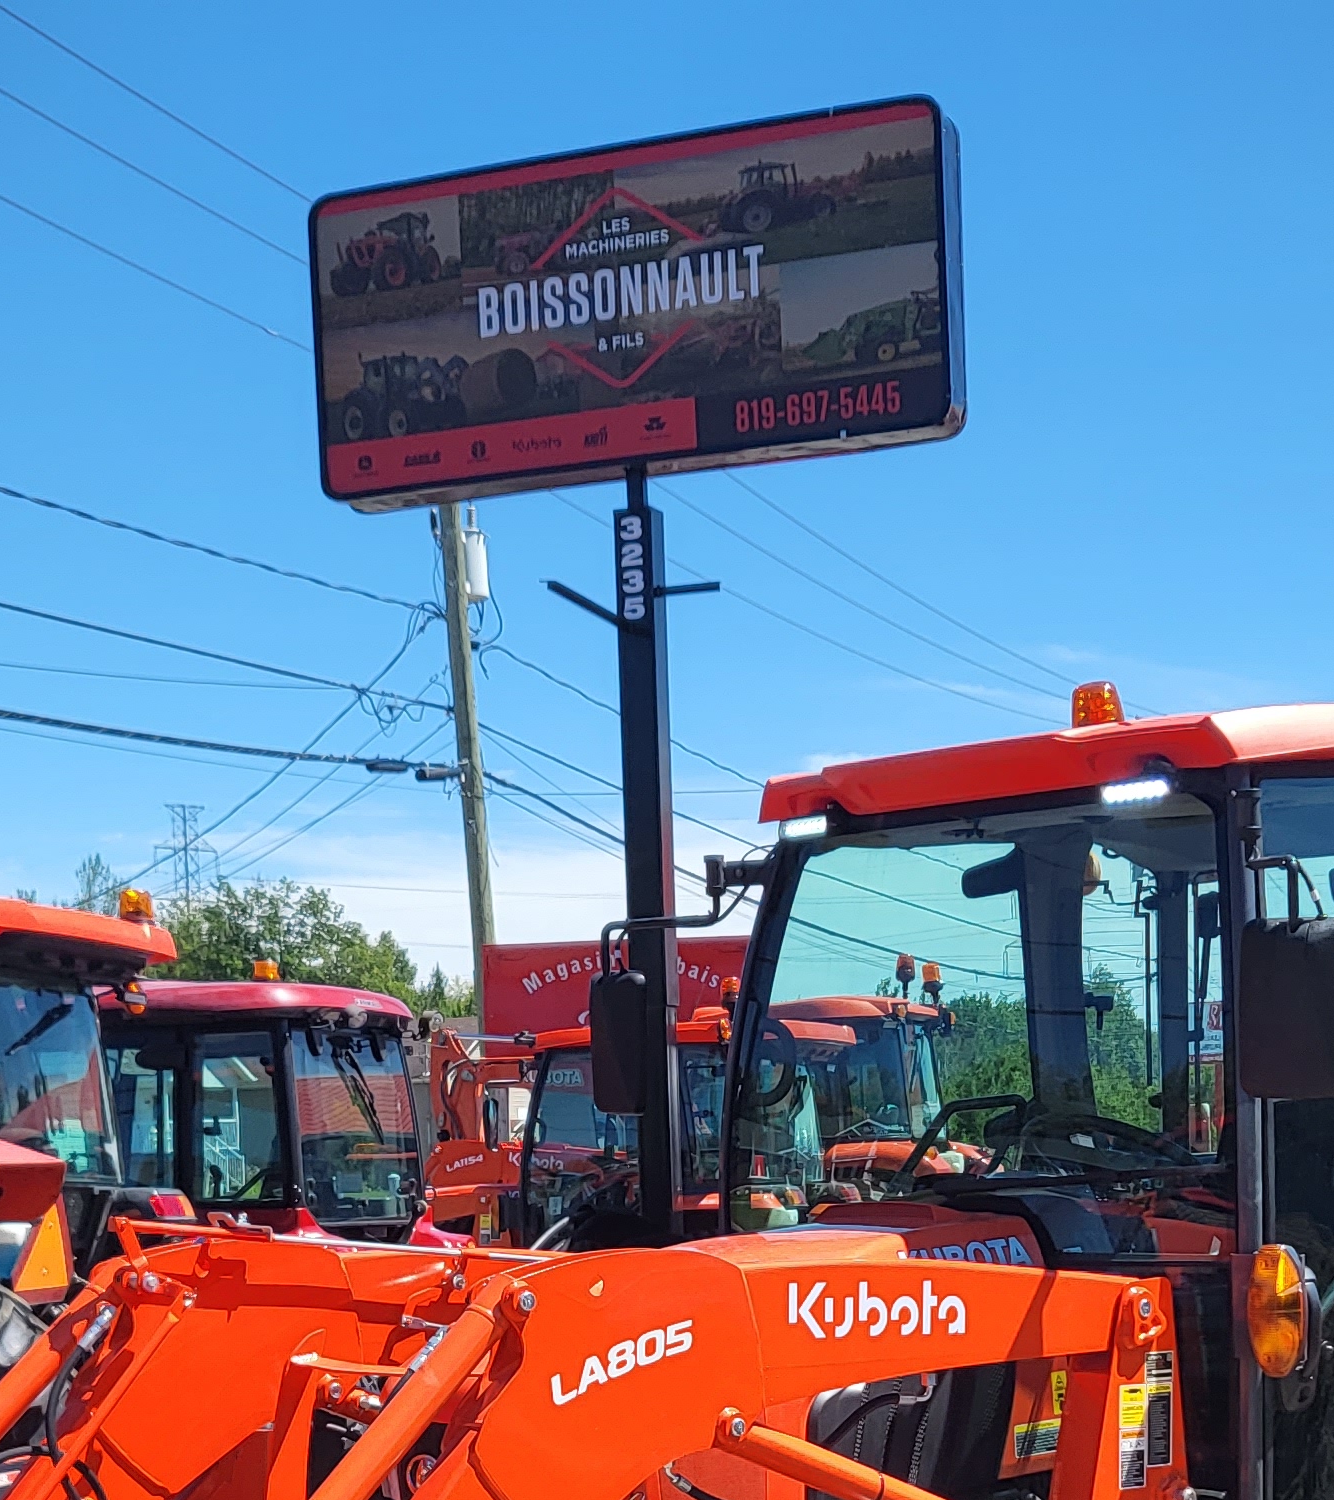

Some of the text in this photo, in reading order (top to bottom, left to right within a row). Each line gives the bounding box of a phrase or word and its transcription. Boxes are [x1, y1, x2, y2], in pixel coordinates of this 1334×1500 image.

[565, 229, 670, 259] MACHINERIES
[602, 217, 630, 235] LES
[478, 244, 764, 339] BOISSONNAULT
[597, 331, 644, 352] & FILS
[735, 380, 901, 433] 819-697-5445
[619, 515, 646, 620] 3235
[446, 1154, 484, 1172] LA1154
[787, 1279, 967, 1339] Kubota
[550, 1319, 693, 1406] LA805
